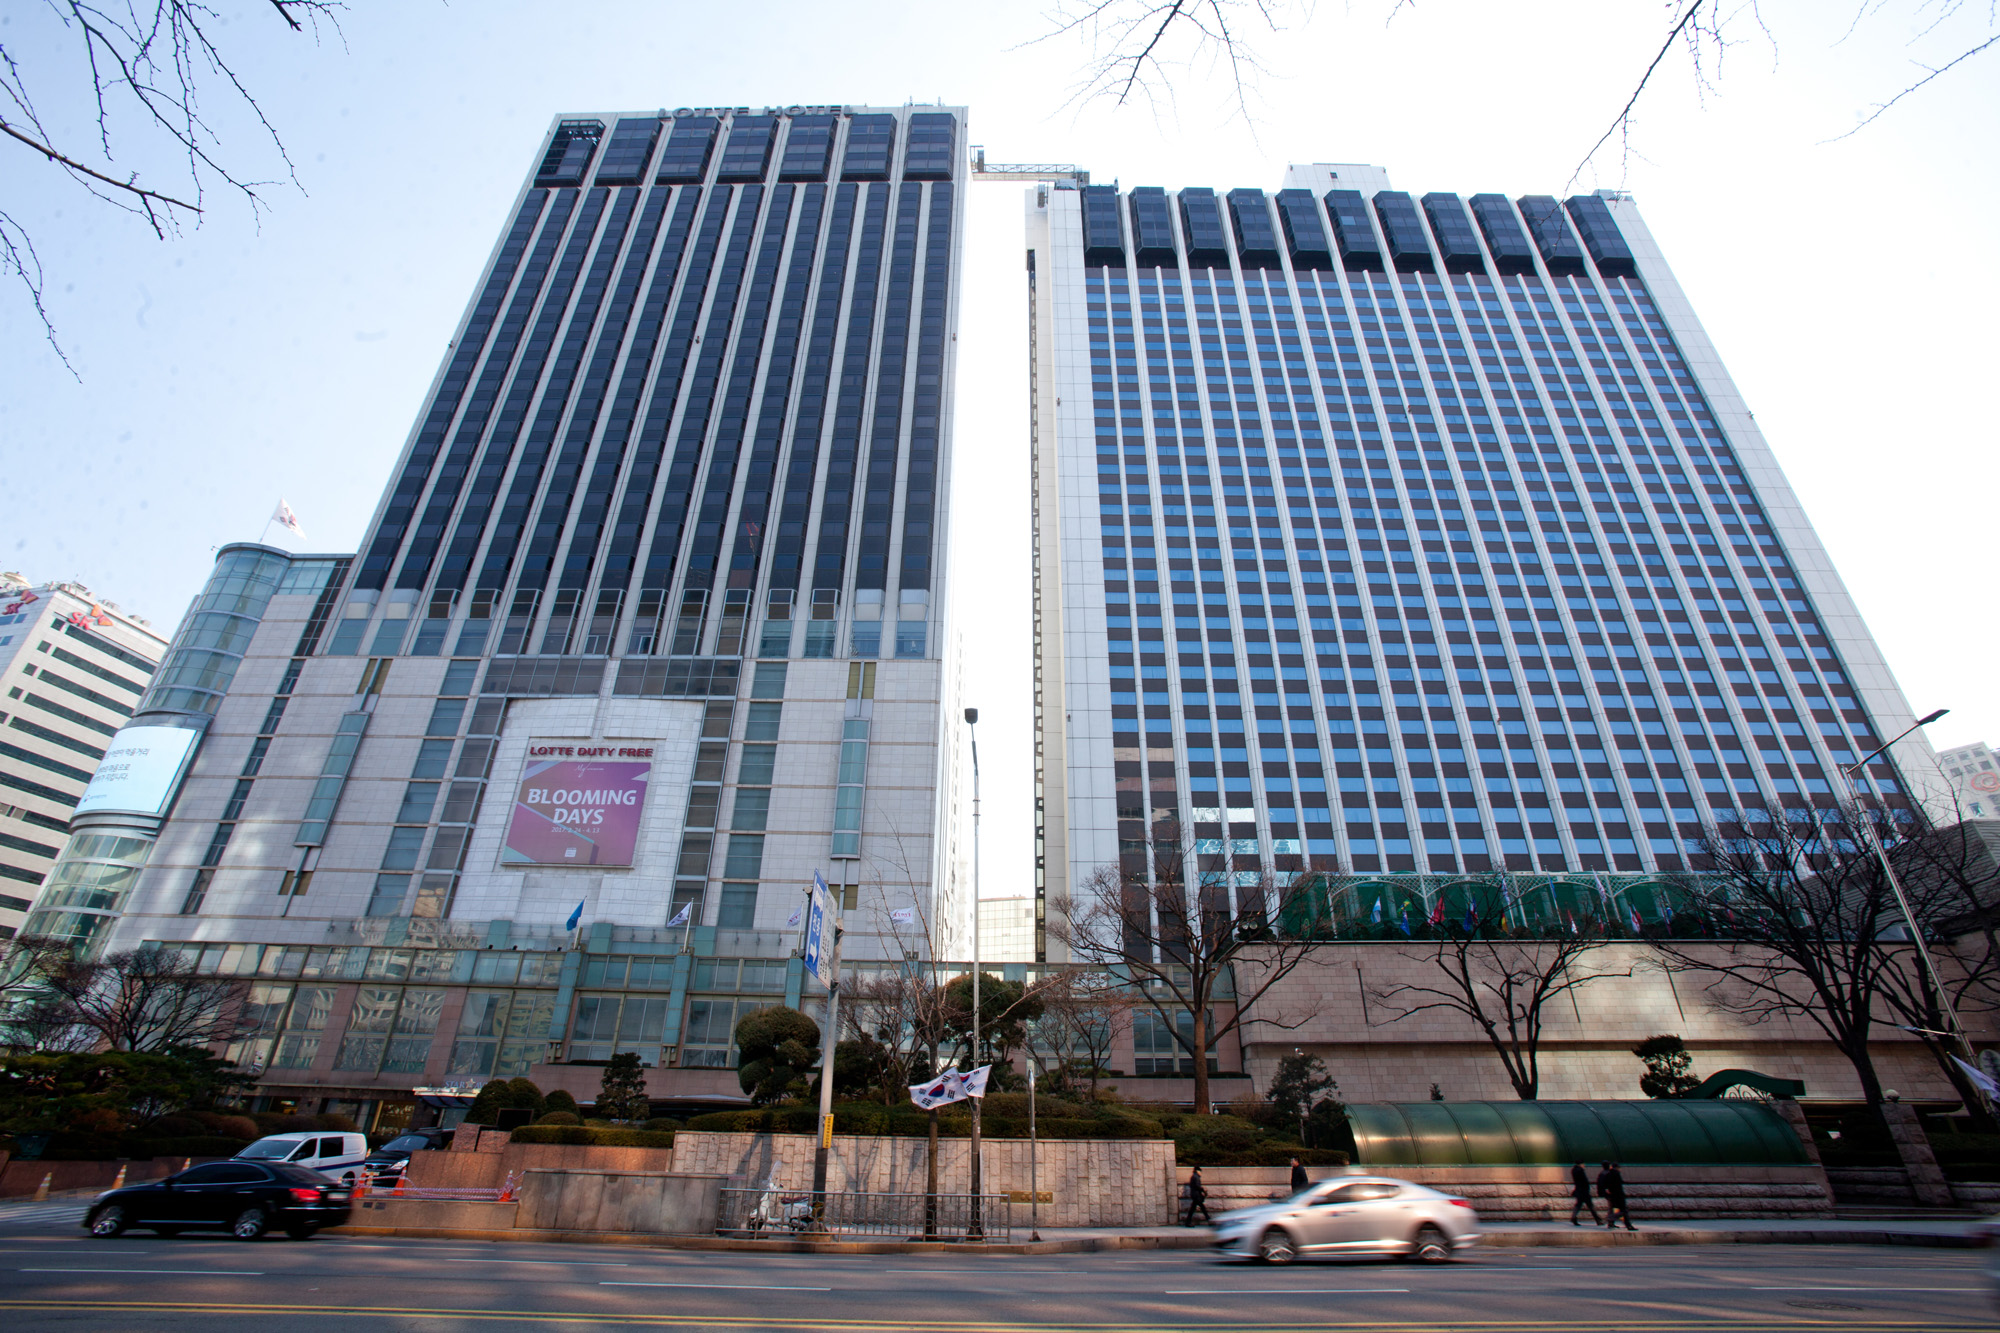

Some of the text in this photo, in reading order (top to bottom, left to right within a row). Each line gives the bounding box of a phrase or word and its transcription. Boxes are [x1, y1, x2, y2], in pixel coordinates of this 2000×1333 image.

[657, 105, 859, 119] LOTTE HOTEL
[67, 611, 94, 630] SK
[530, 746, 654, 757] LOTTE DUTY FREE
[527, 788, 637, 805] BLOOMING
[553, 808, 605, 824] DAYS
[445, 1080, 466, 1089] STAR
